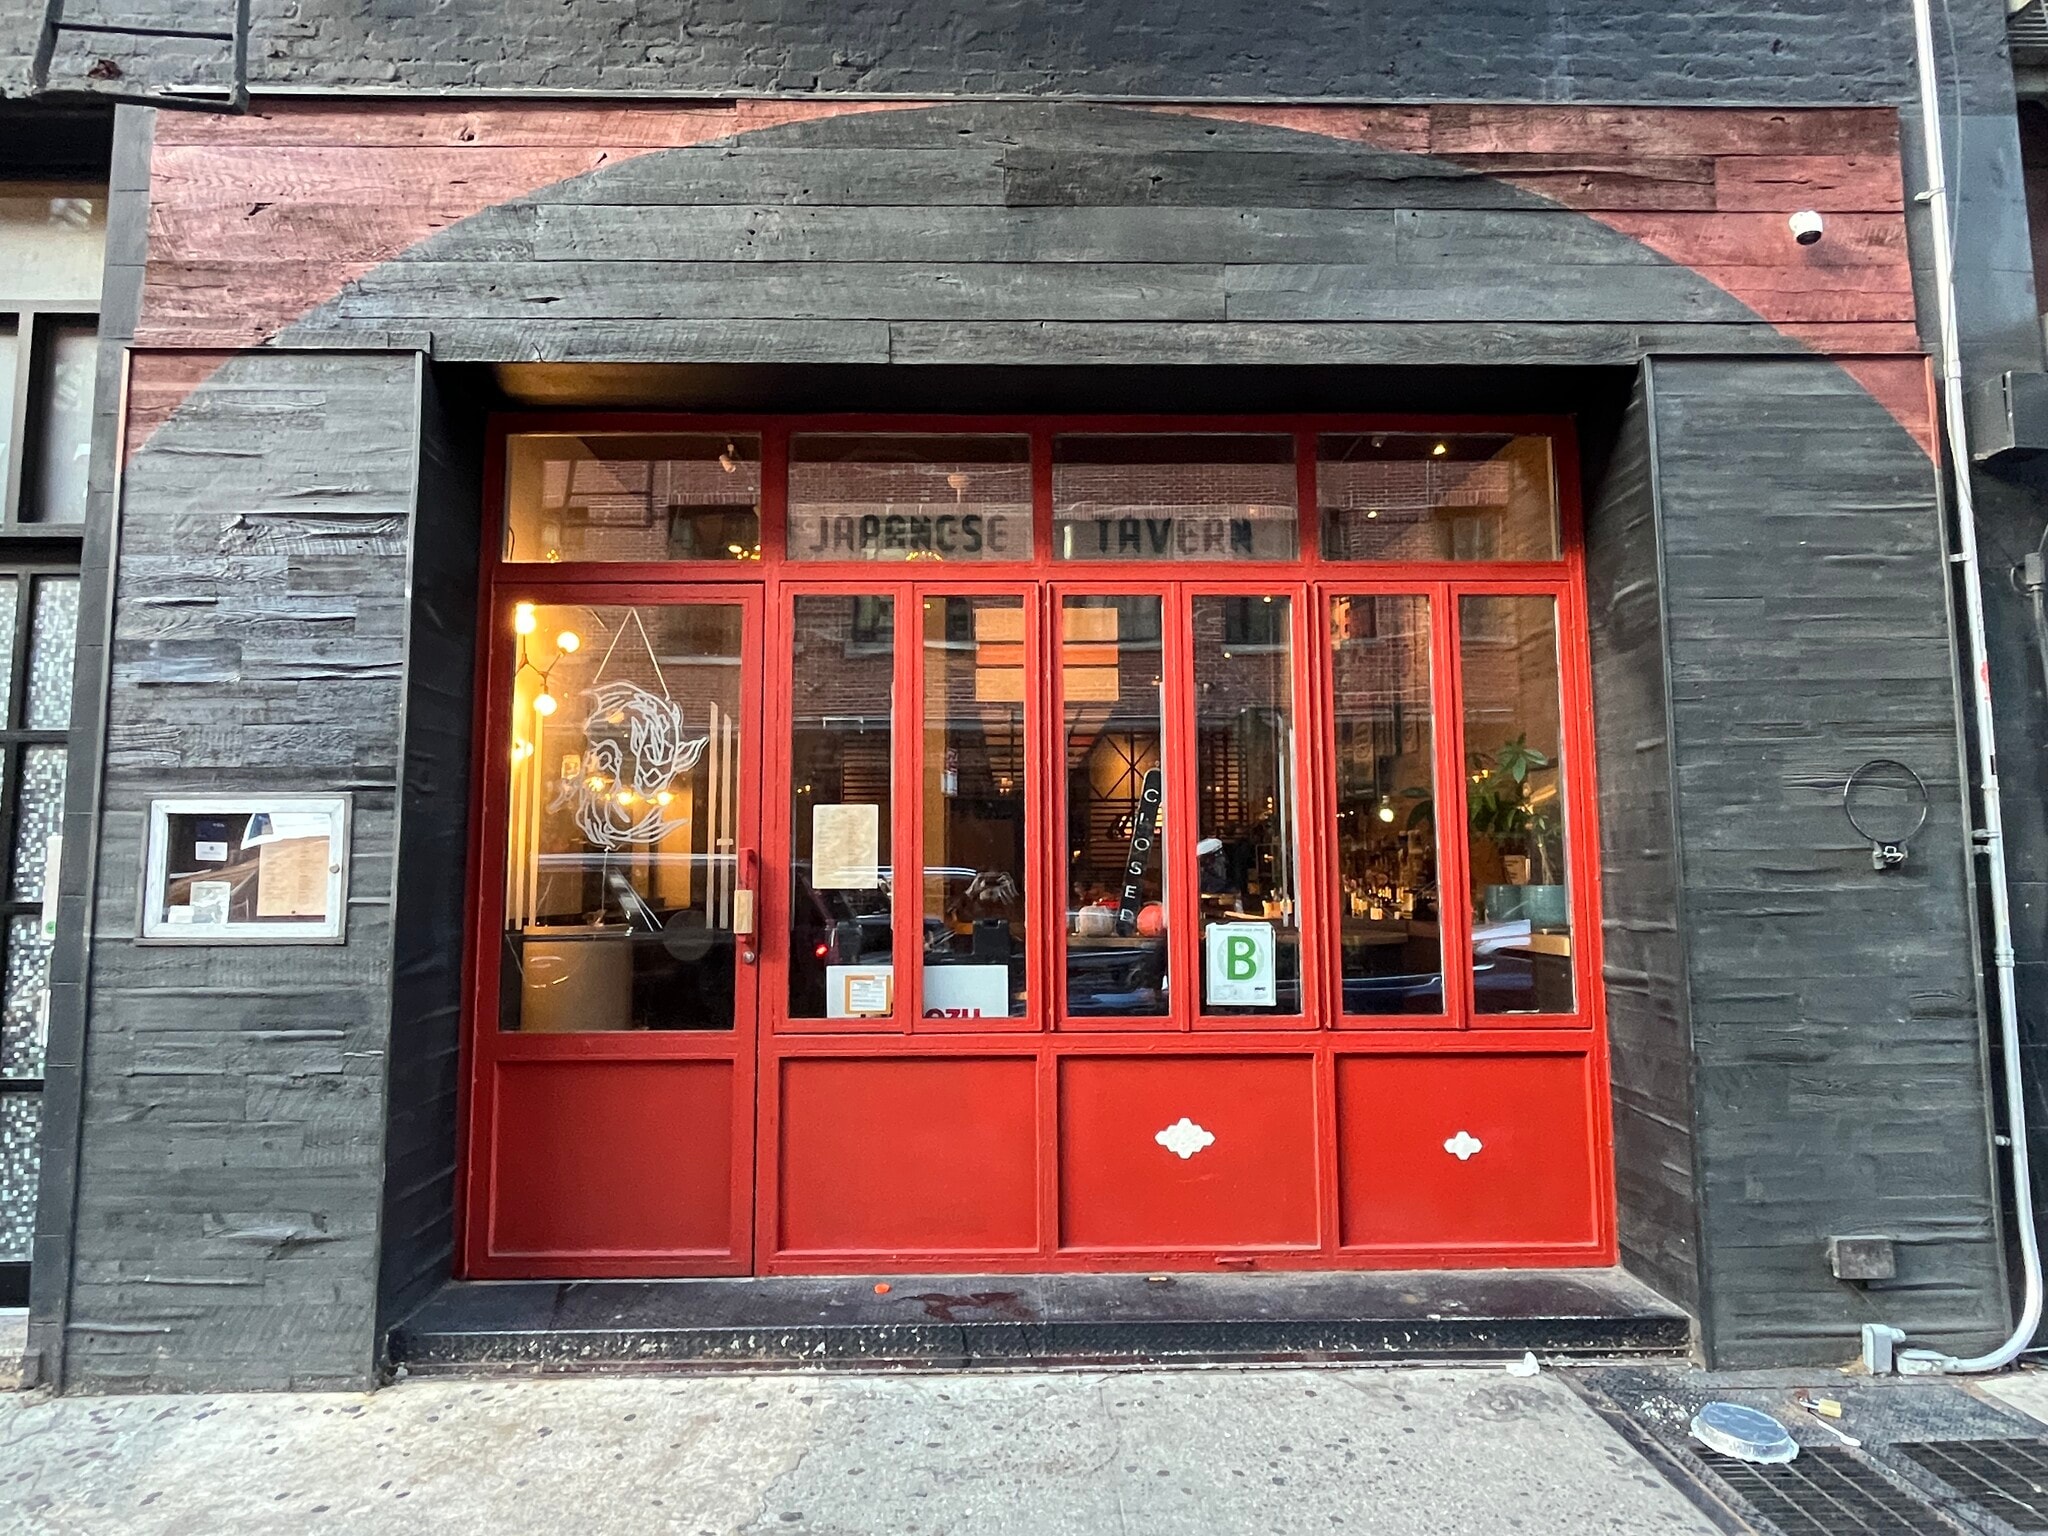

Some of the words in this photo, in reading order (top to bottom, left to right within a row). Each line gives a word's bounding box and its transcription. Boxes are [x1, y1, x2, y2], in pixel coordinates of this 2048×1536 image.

[809, 514, 1008, 553] JAPANESE
[1095, 517, 1253, 554] TAVERN
[1119, 788, 1160, 923] CLOSED
[1227, 935, 1257, 981] B
